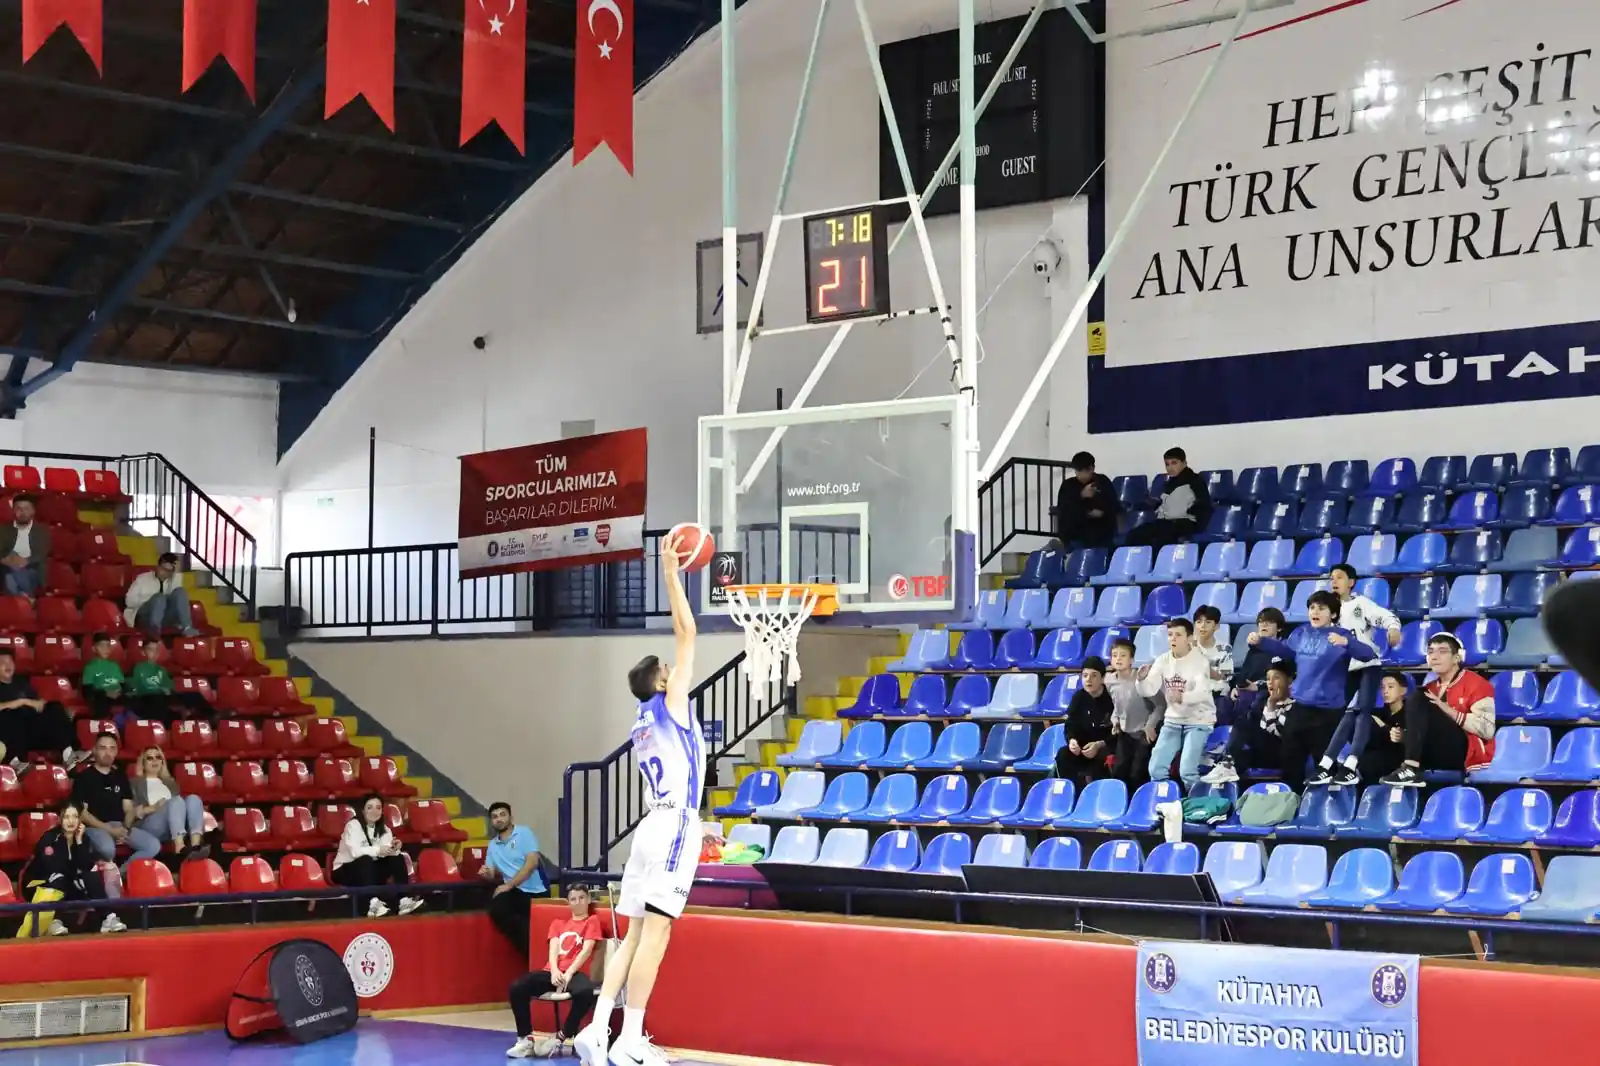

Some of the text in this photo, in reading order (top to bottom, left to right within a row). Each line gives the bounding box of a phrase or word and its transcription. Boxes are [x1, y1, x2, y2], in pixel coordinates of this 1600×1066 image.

[1001, 155, 1036, 177] GUEST
[1168, 162, 1320, 228] TÜRK
[815, 212, 872, 247] 7:18
[818, 255, 866, 313] 21
[1131, 242, 1249, 300] ANA
[536, 454, 568, 475] TÜM
[485, 470, 618, 502] SPORCULARIMIZA
[787, 482, 861, 497] www.tbf.org.tr
[486, 494, 617, 526] BAŞARILAR DİLERİM.
[911, 575, 949, 597] TBF
[640, 756, 671, 800] 12
[1217, 974, 1323, 1009] KÜTAHYA
[1145, 1016, 1405, 1059] BELEDİYESPOR KULÜBÜ
